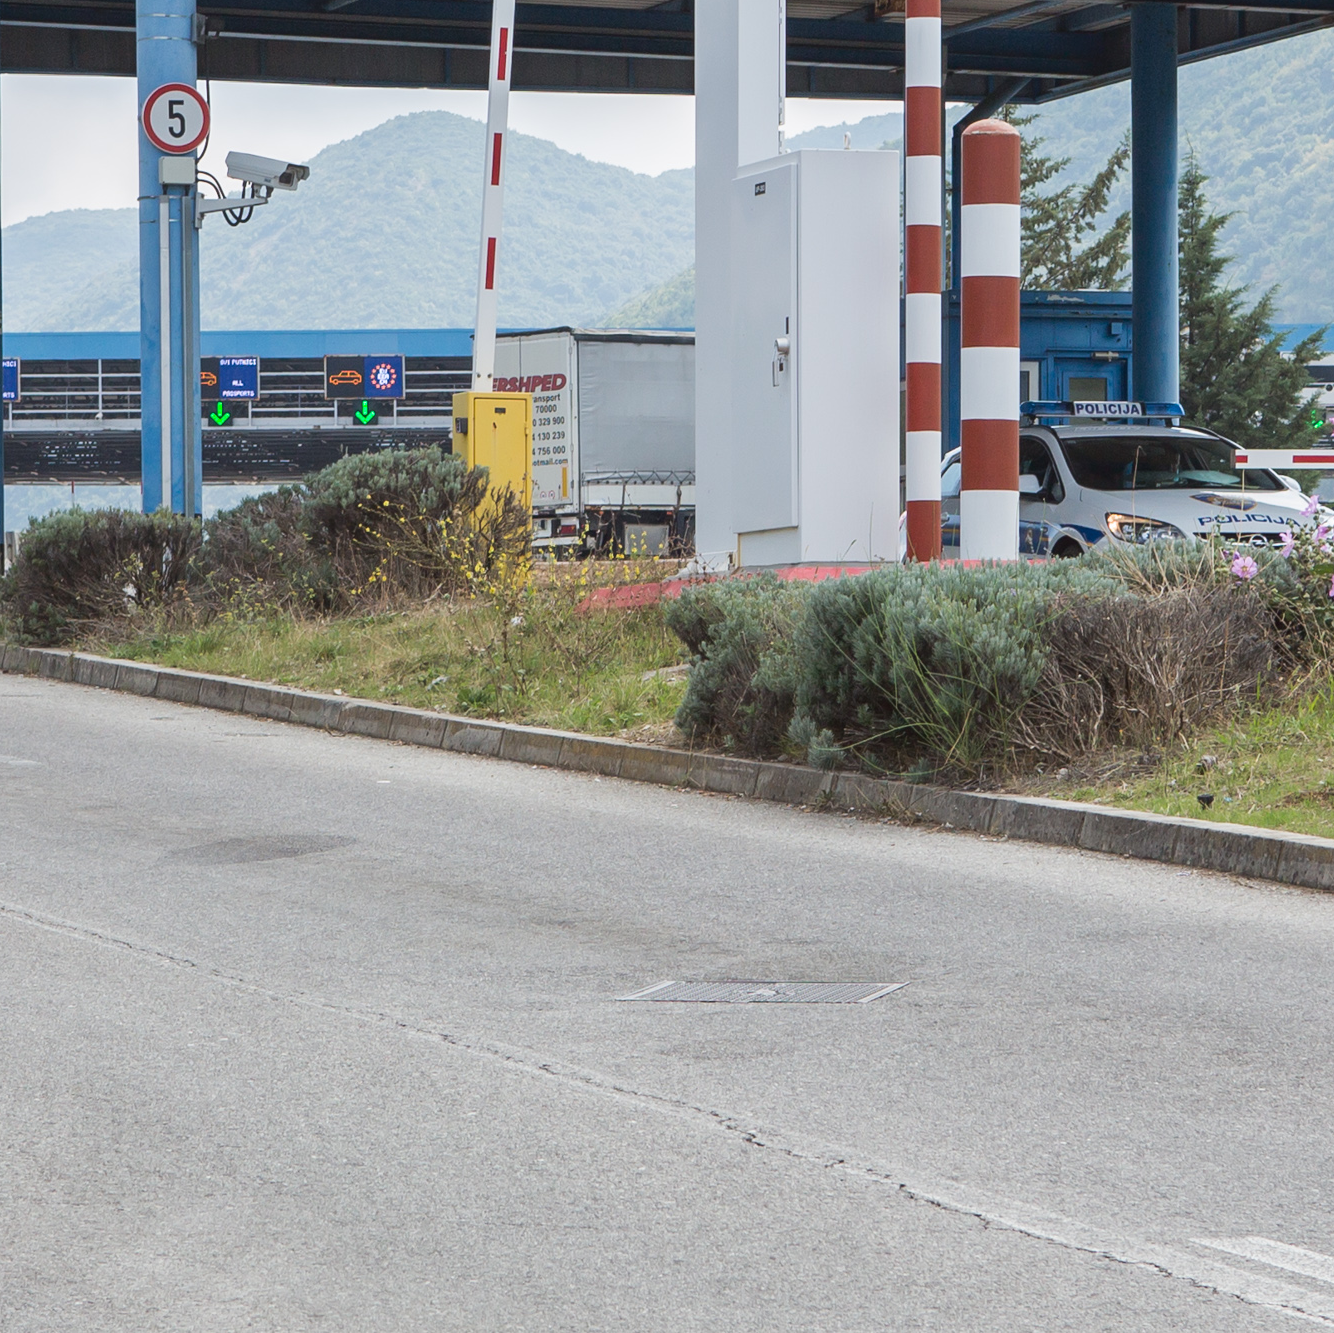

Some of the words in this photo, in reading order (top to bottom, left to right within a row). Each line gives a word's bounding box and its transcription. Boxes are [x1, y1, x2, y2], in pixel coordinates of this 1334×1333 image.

[168, 100, 186, 139] 5
[492, 373, 567, 393] ERSHPED
[1075, 402, 1141, 416] POLICIJA
[538, 418, 551, 426] 329
[552, 416, 565, 425] 900
[552, 446, 566, 454] 000
[532, 458, 568, 466] otmail.com
[1198, 513, 1301, 527] POLICIJA
